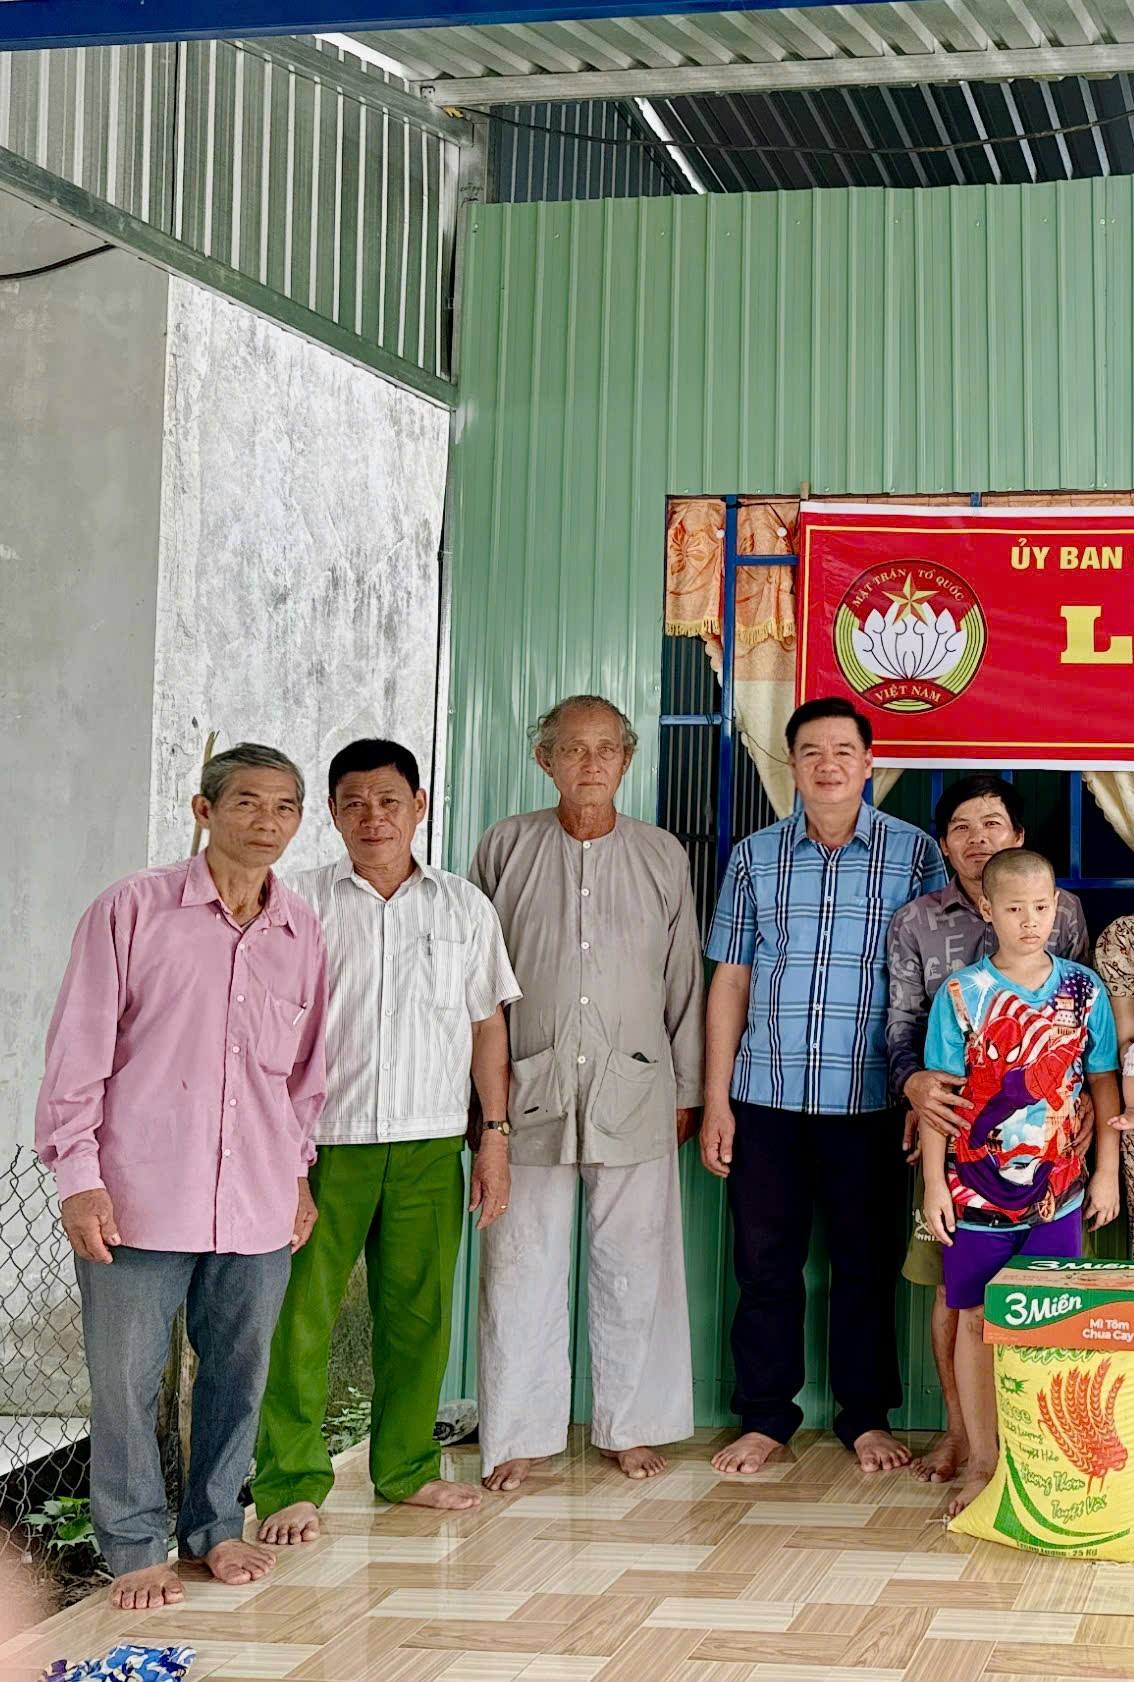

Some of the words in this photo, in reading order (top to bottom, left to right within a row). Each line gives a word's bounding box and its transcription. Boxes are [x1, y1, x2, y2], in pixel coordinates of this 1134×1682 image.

[1011, 537, 1049, 570] ỦY
[1059, 546, 1123, 570] BAN
[911, 686, 941, 703] NAM
